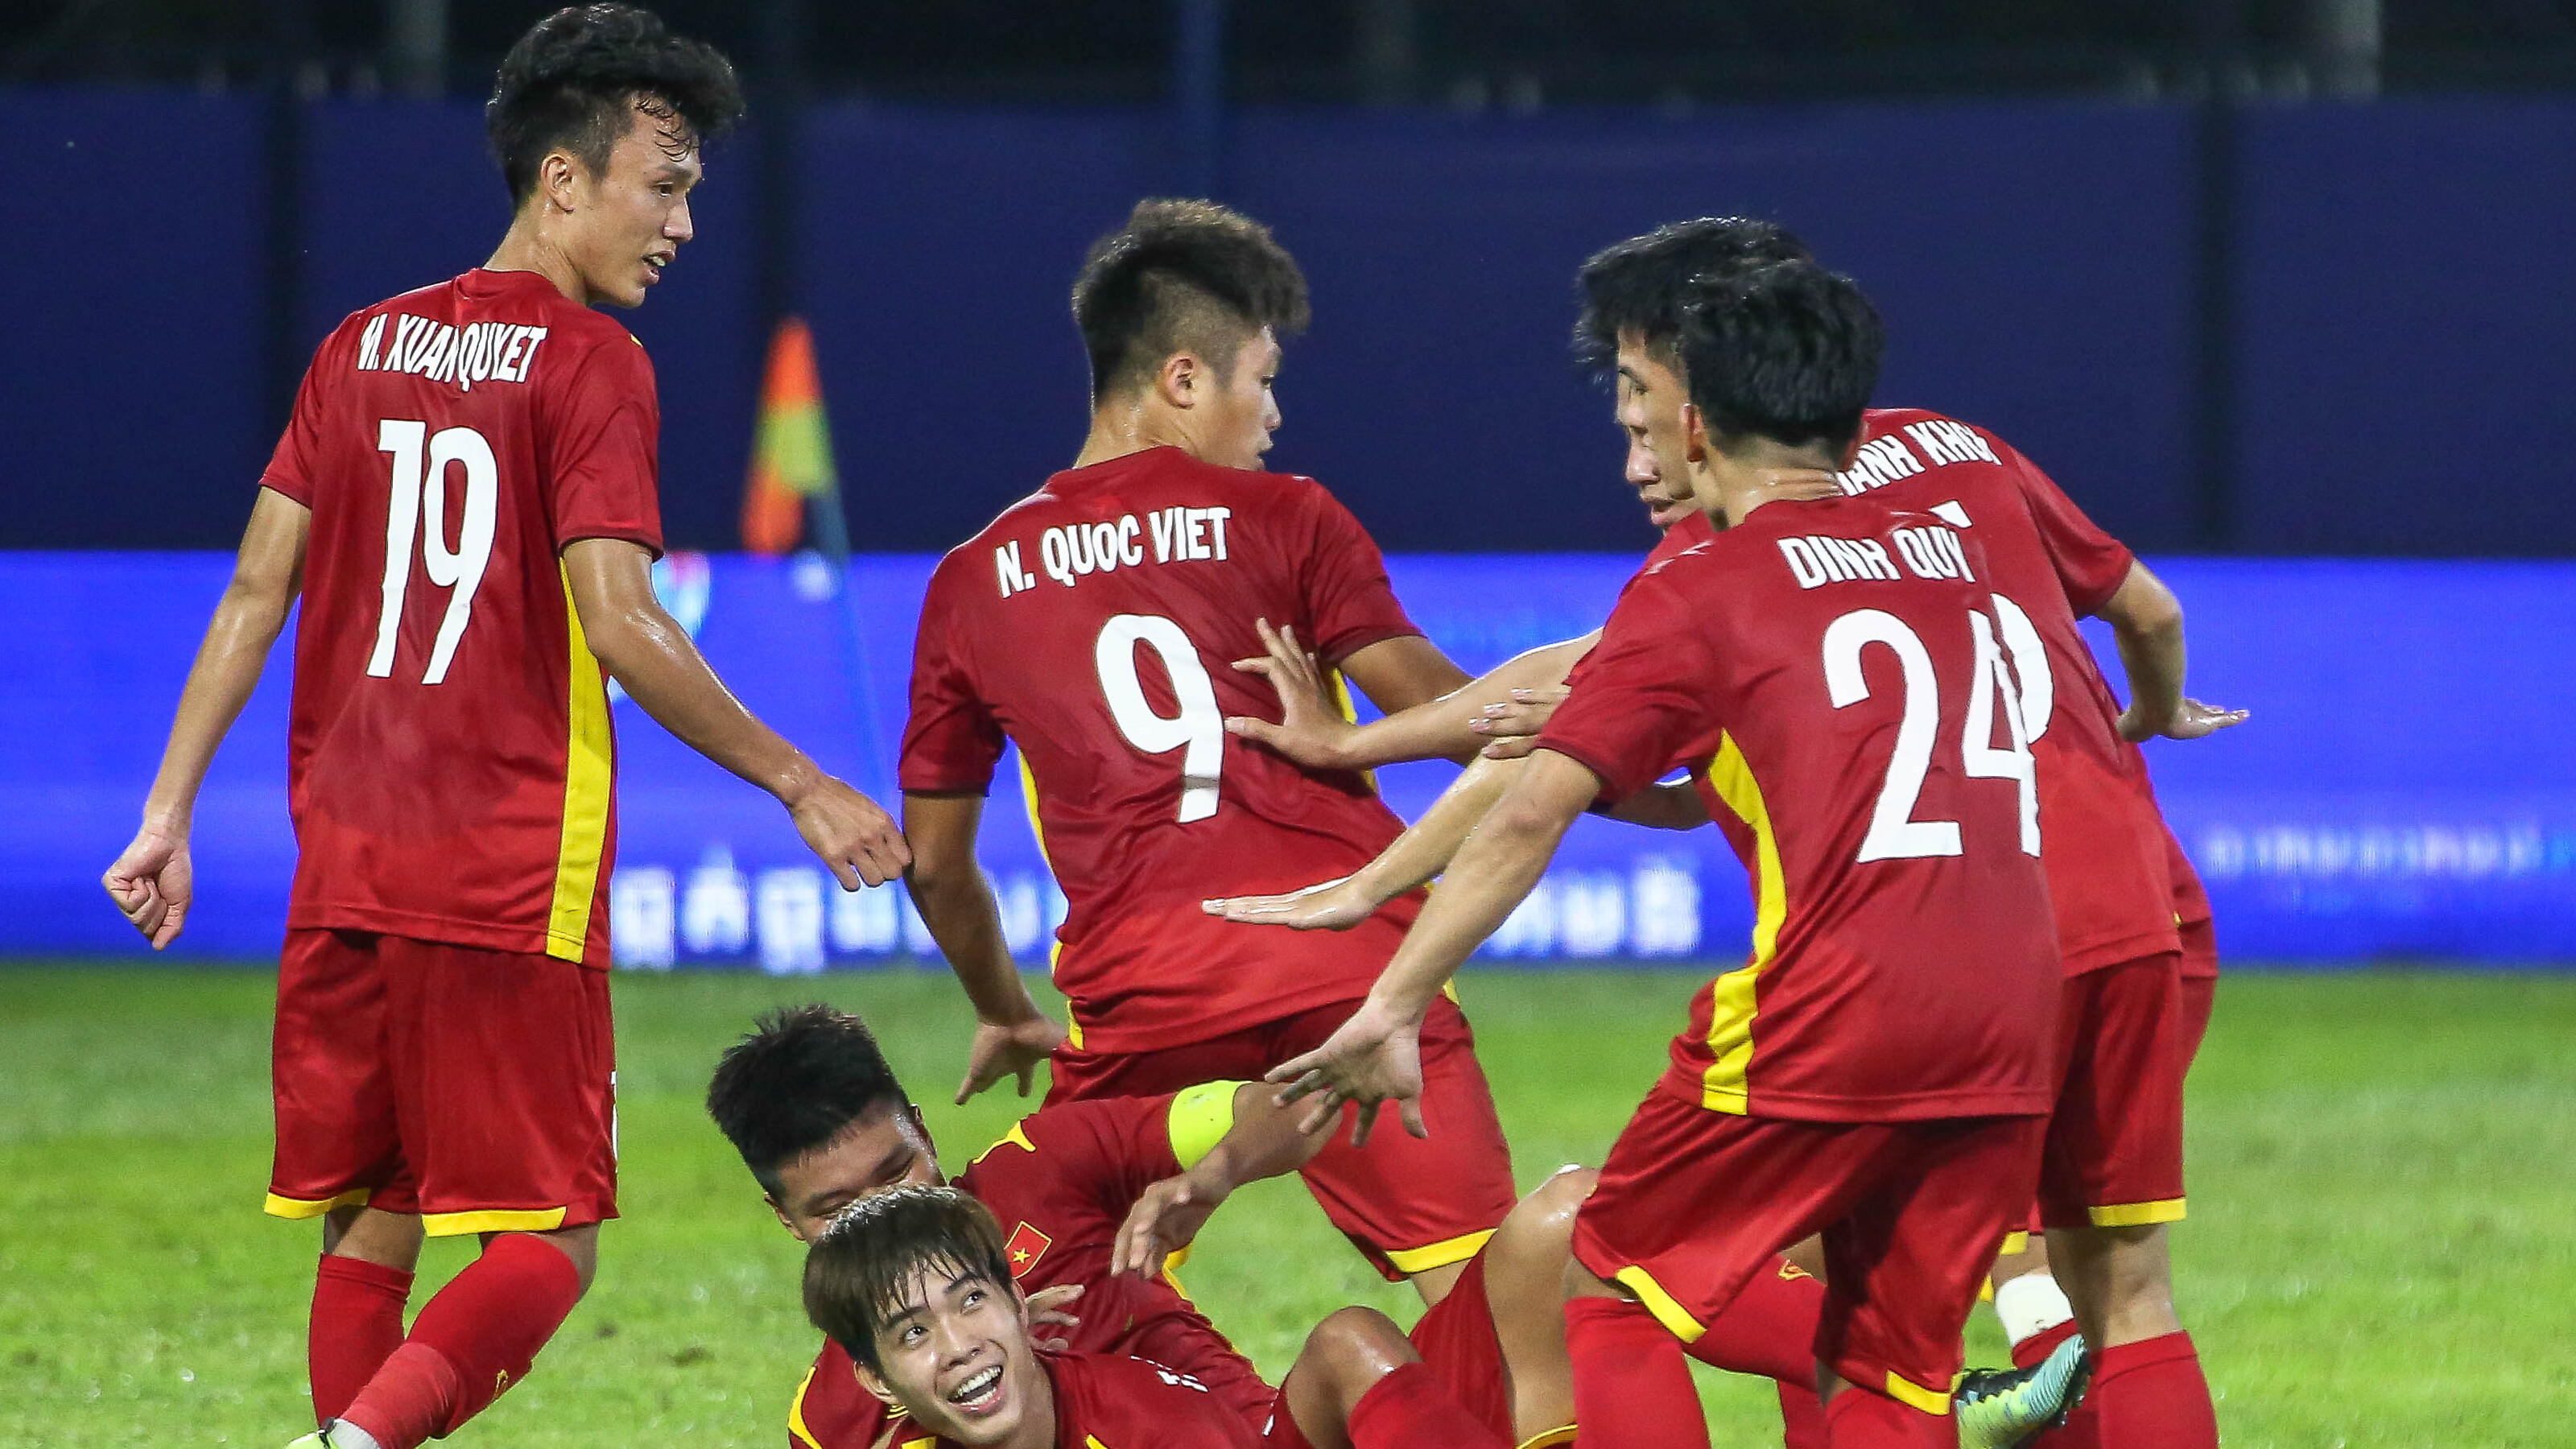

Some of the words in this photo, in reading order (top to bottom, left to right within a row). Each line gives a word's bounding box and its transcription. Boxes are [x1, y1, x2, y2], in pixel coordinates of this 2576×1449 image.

[366, 419, 497, 684] 19
[995, 541, 1036, 598] N.
[1043, 514, 1143, 587] QUOC
[1149, 507, 1231, 563] VIET
[1777, 535, 1901, 590] DINH
[1892, 526, 1975, 583] QUY
[1095, 613, 1224, 823] 9
[1823, 609, 2042, 864] 24
